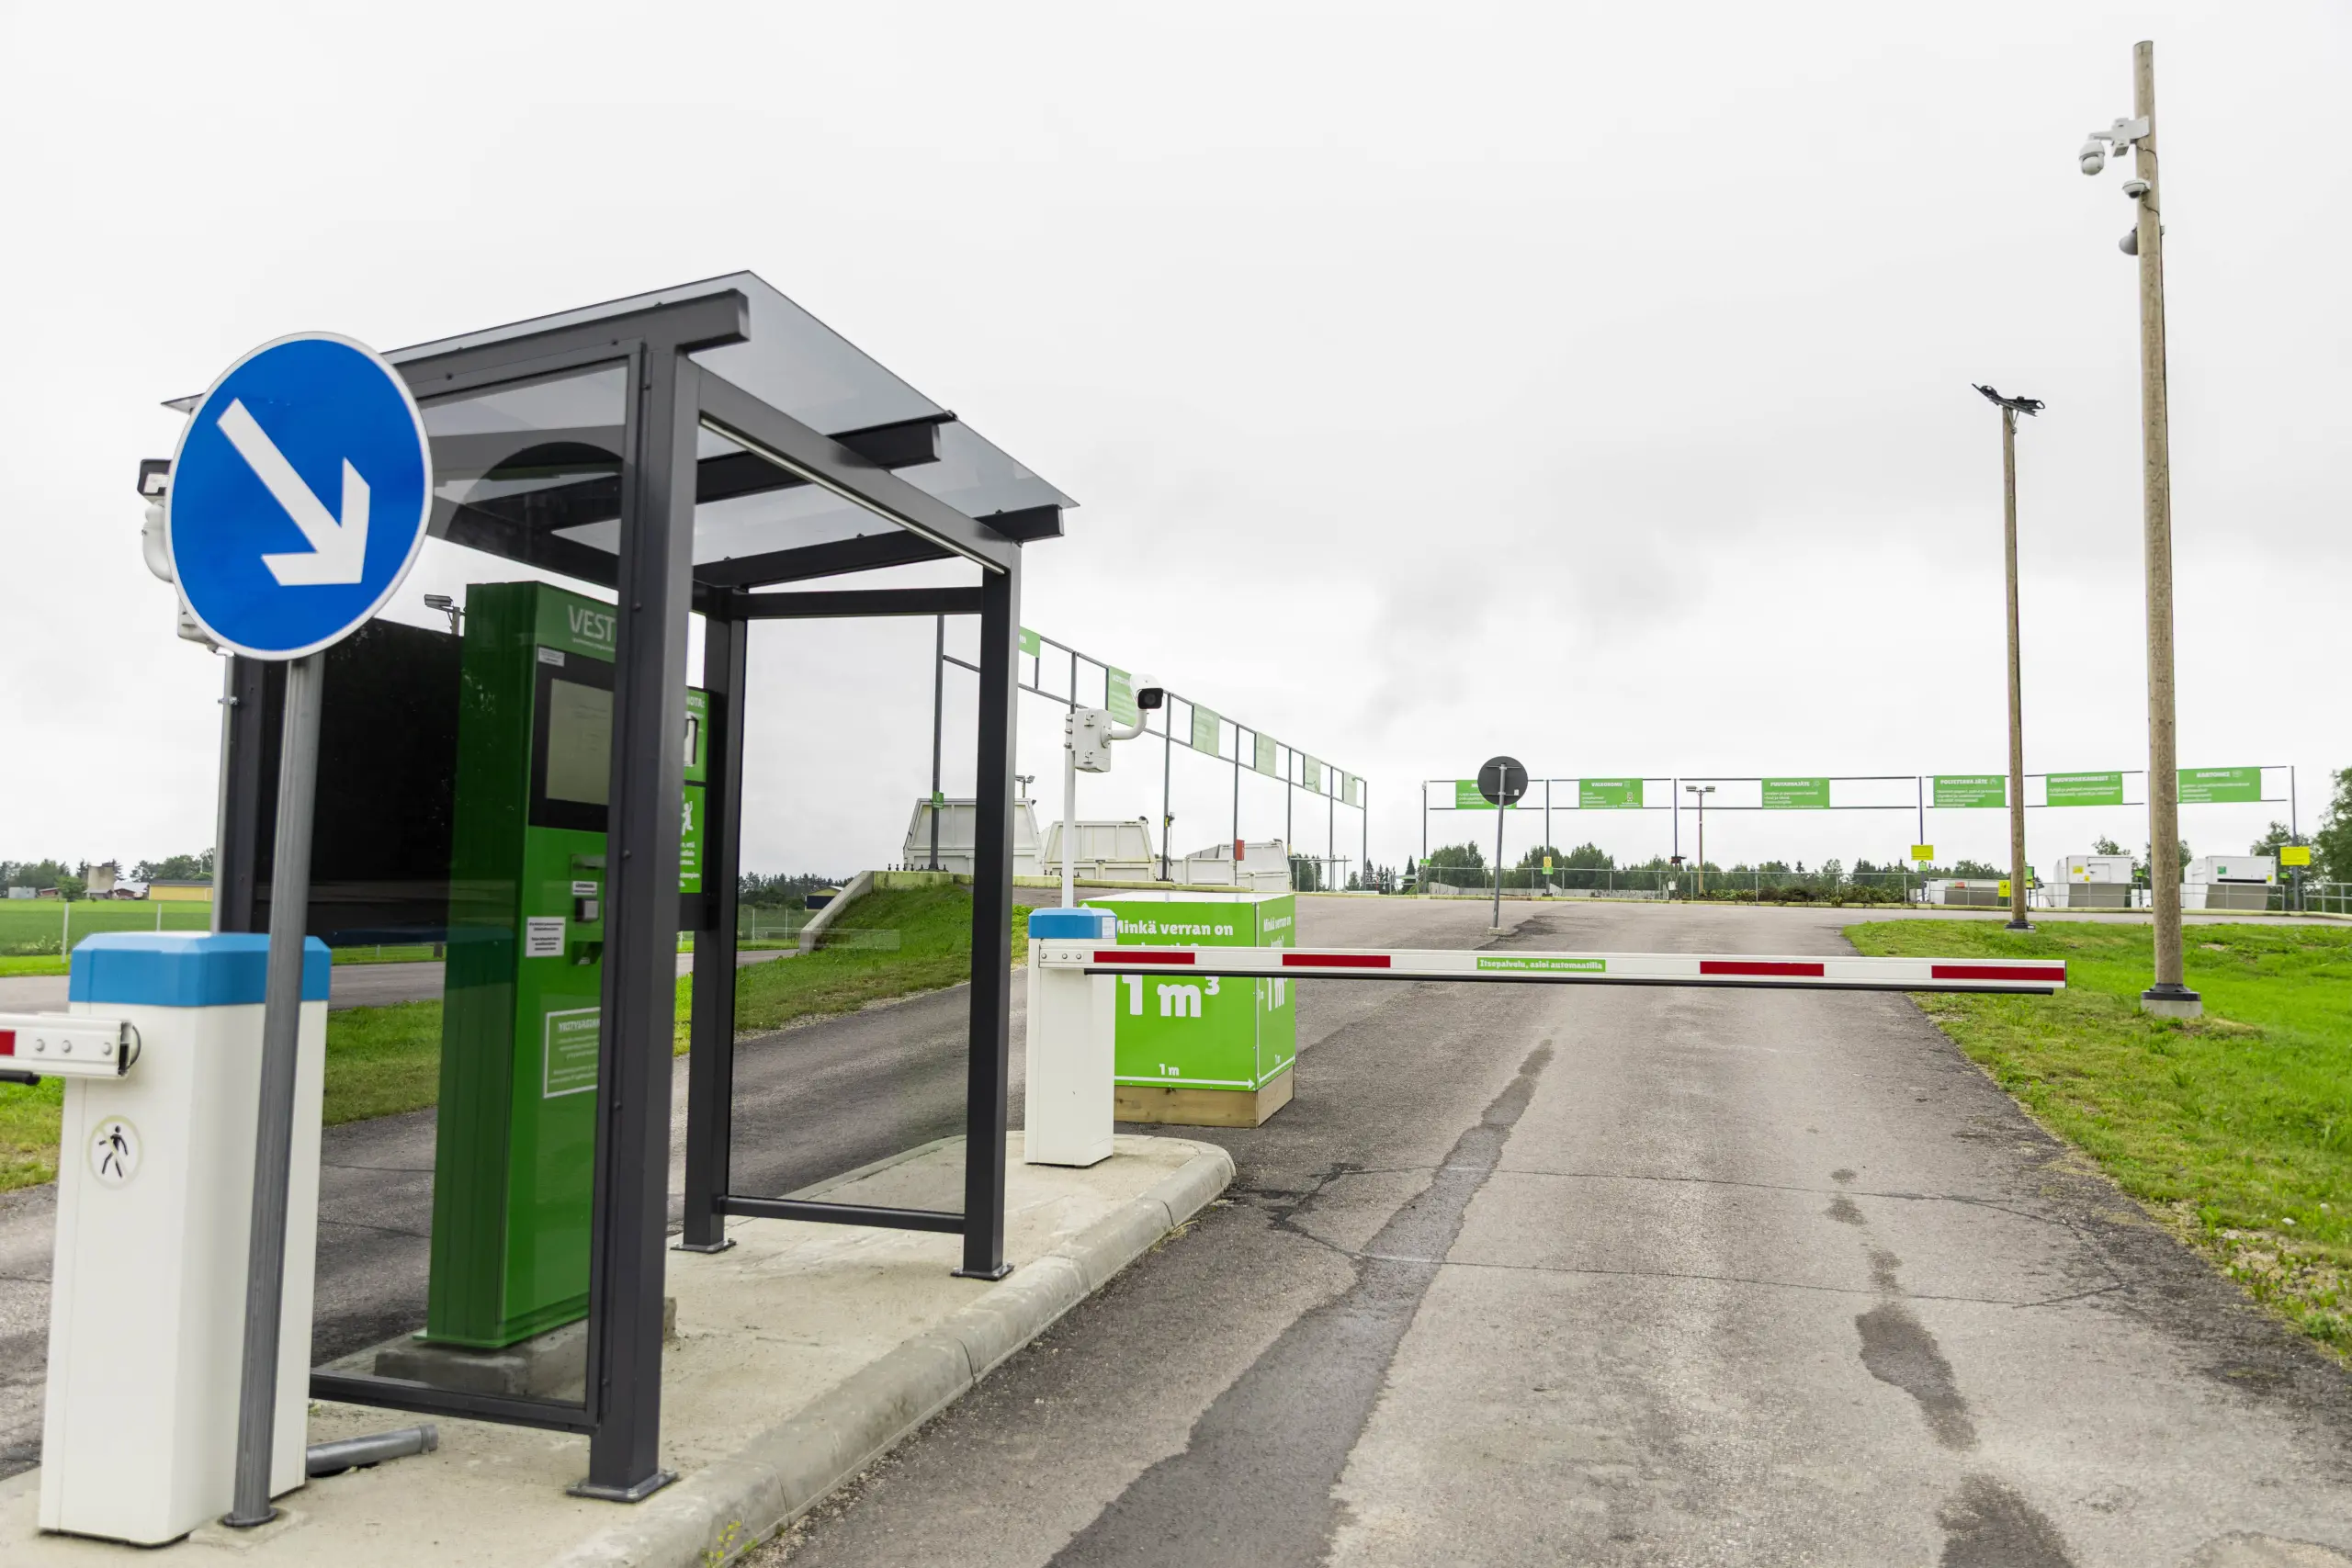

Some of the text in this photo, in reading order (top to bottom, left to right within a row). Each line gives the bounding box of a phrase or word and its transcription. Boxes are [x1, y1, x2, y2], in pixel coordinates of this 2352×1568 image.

[1159, 922, 1211, 935] verran
[1214, 924, 1234, 936] on
[1479, 959, 1603, 970] Itsepalvelu, asioi automaatilla
[1159, 1064, 1180, 1076] 1 m
